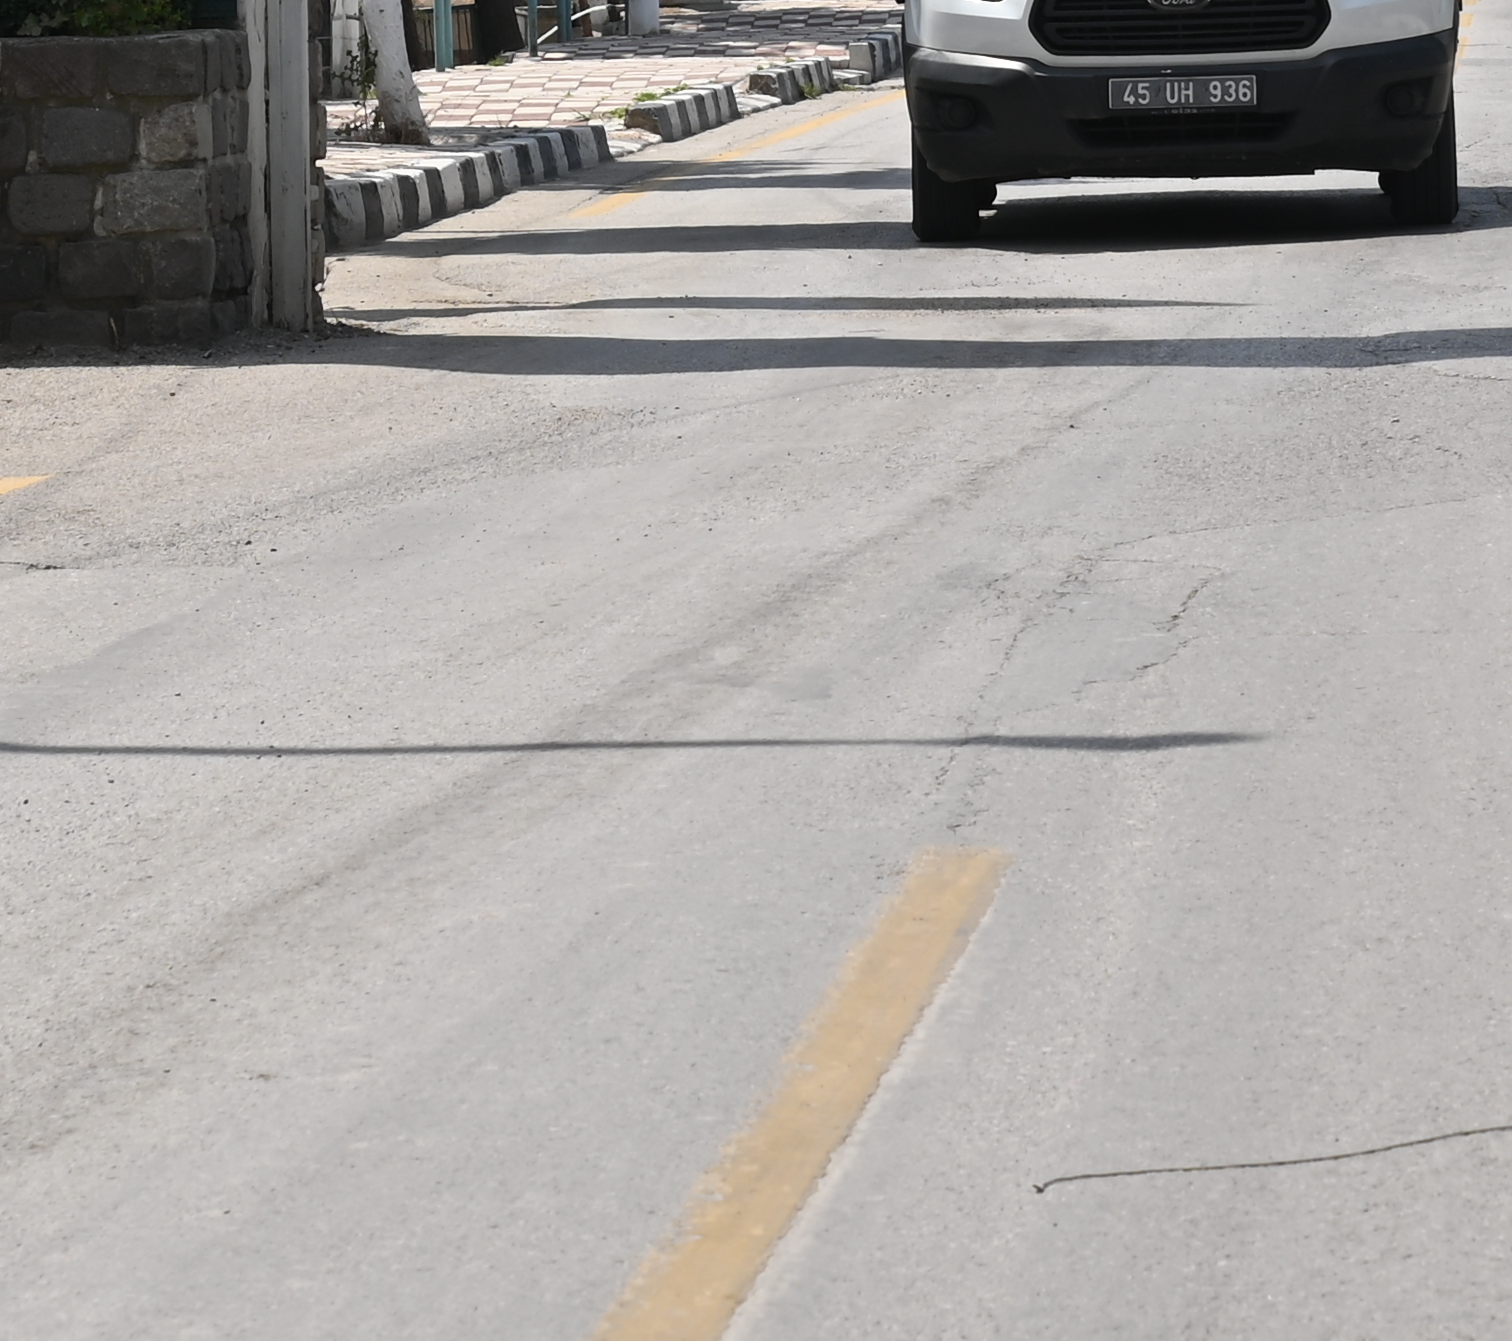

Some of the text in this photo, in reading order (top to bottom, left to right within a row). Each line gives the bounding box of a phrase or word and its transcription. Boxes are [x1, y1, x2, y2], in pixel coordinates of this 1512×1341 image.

[1123, 80, 1252, 105] 45 UH 936
